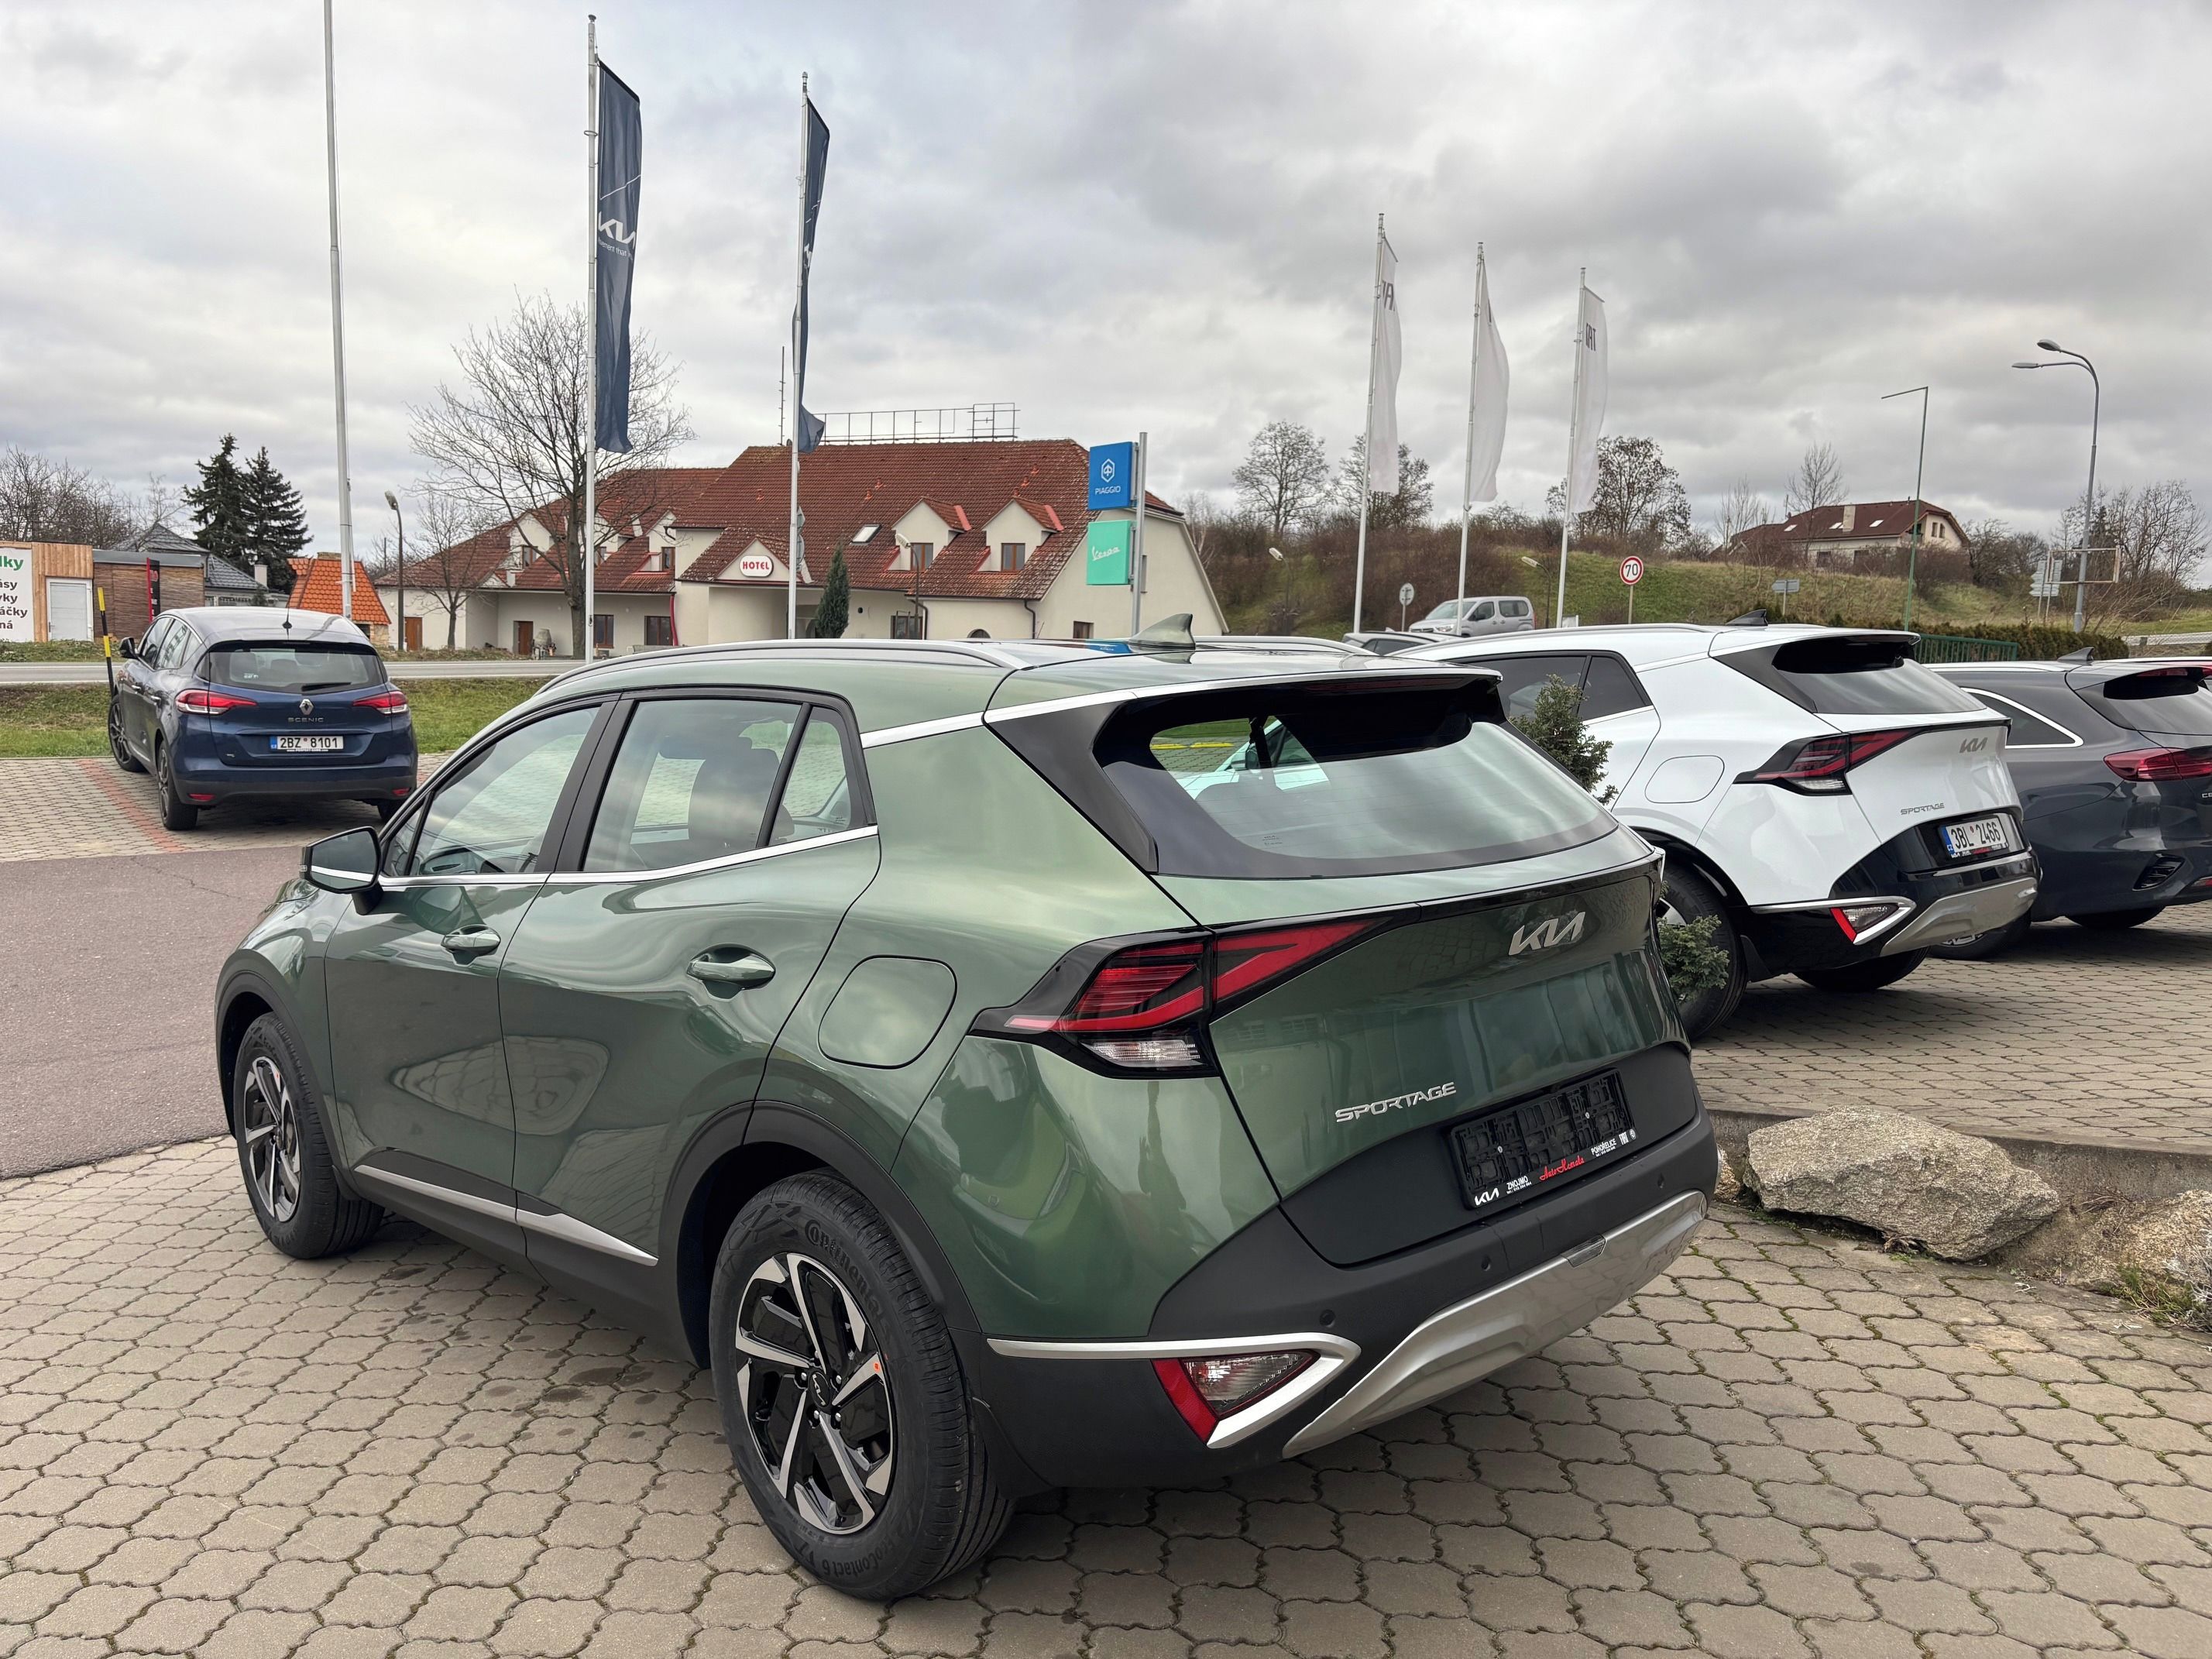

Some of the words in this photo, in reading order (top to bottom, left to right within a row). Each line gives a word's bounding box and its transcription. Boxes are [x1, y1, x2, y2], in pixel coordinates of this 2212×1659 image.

[1094, 485, 1121, 496] PIAGGIO
[1091, 545, 1121, 562] Vespa
[742, 562, 770, 570] HOTEL
[1625, 563, 1638, 577] 70
[280, 737, 301, 748] 2BZ
[310, 737, 338, 748] 8101
[1900, 802, 1945, 815] SPORTAGE
[1950, 826, 1974, 850] 3BL
[1975, 821, 2001, 844] 2466
[1335, 1081, 1457, 1123] SPORTAGE
[1506, 1175, 1529, 1190] ZNOJMO
